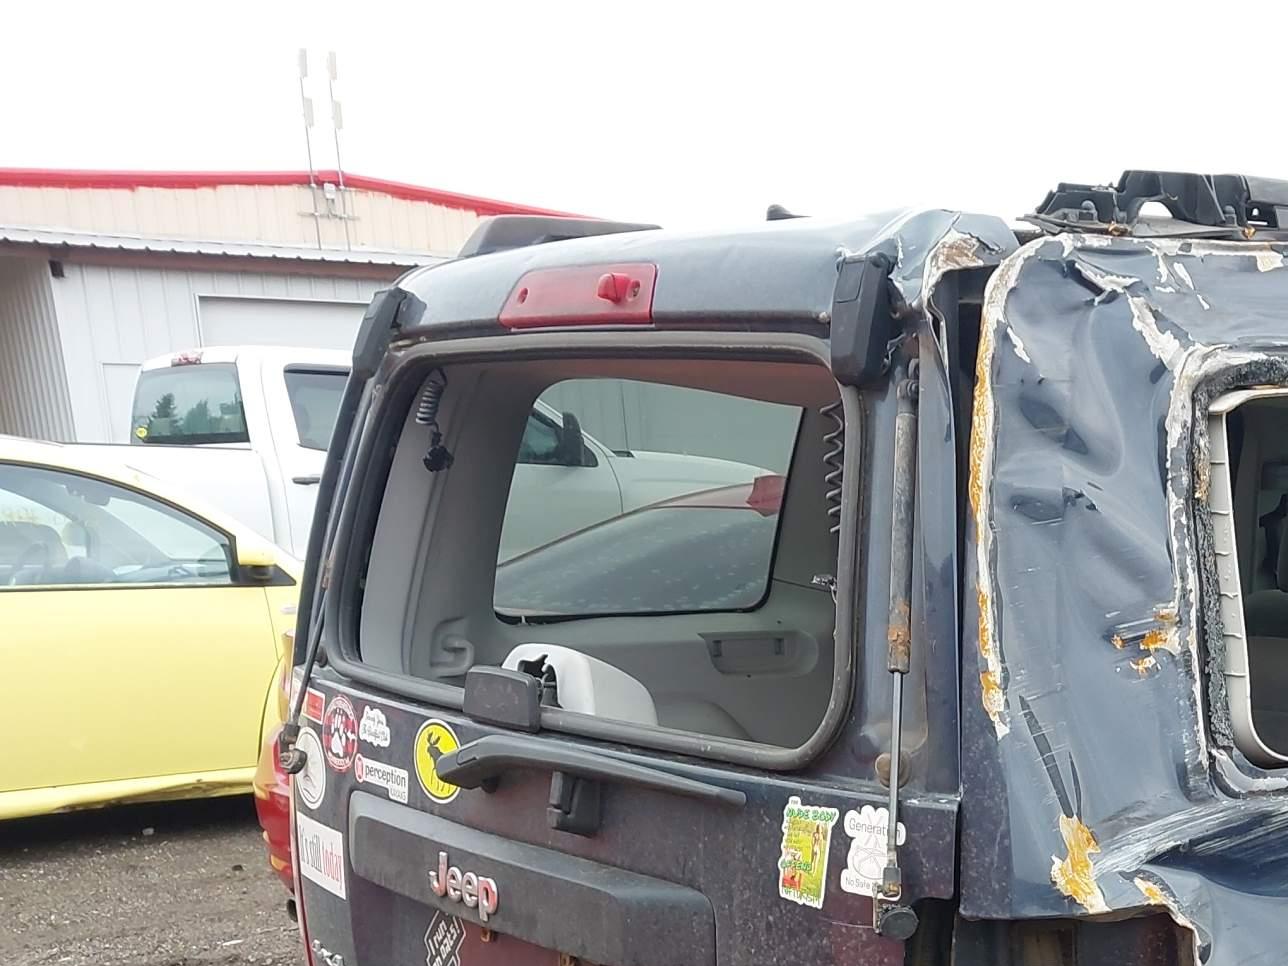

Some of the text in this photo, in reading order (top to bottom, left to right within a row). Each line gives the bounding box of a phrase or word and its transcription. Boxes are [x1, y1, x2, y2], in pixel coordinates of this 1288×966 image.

[365, 765, 406, 788] perception
[849, 817, 901, 839] Generatn
[322, 840, 343, 891] today
[428, 851, 499, 922] Jeep
[428, 920, 448, 956] I run
[440, 916, 460, 960] oats!
